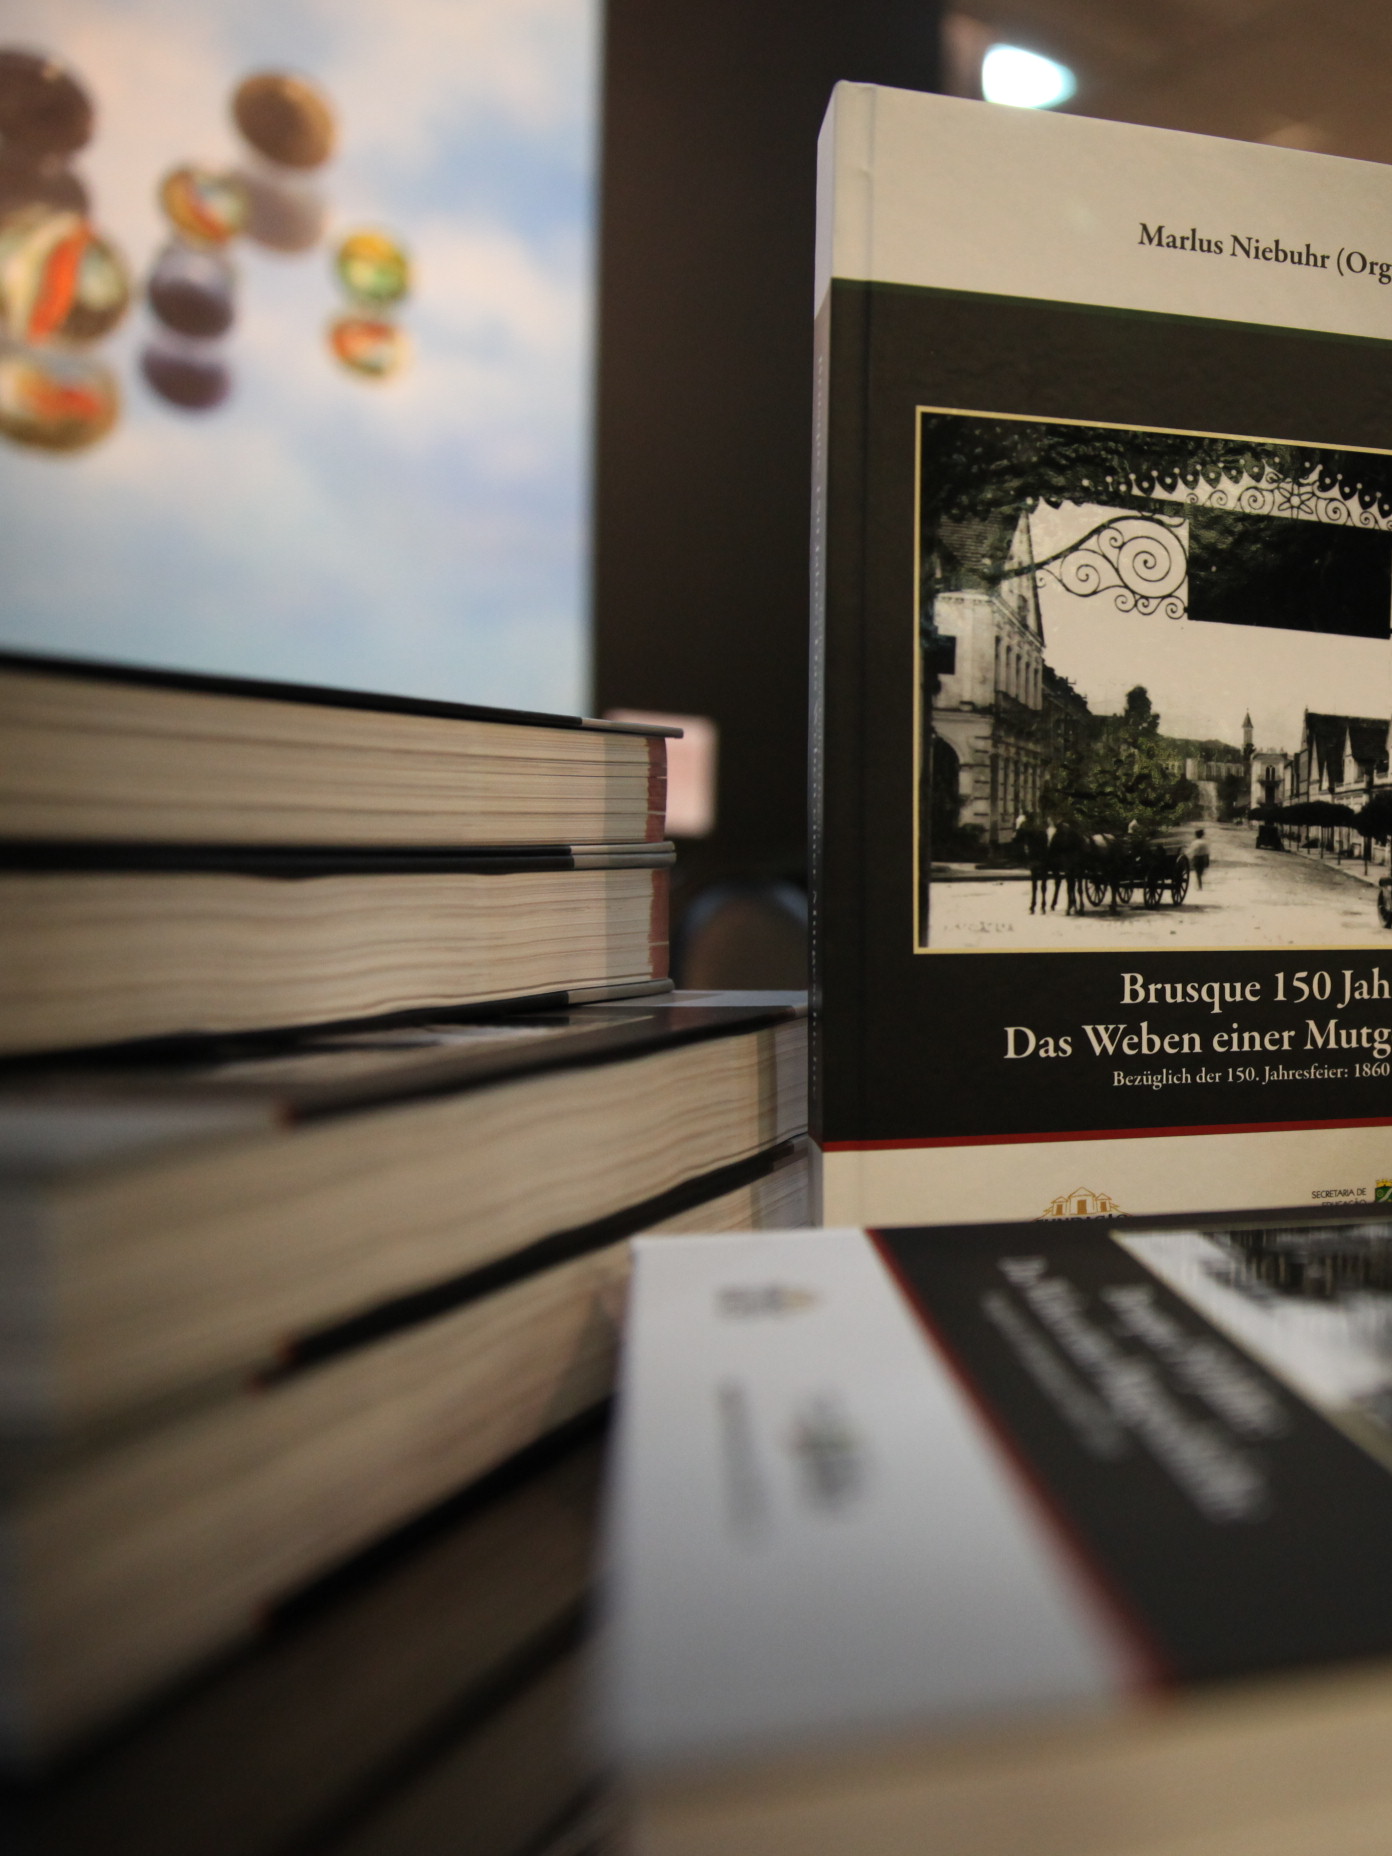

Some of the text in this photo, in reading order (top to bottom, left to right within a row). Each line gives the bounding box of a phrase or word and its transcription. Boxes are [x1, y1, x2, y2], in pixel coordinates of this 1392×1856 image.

[1138, 223, 1223, 254] Marlus
[1230, 234, 1330, 268] Niebuhr
[1120, 972, 1261, 1013] Brusque
[1274, 970, 1331, 1003] 150
[1003, 1026, 1072, 1059] Das
[1081, 1021, 1202, 1056] Weben
[1212, 1022, 1295, 1052] einer
[1113, 1068, 1191, 1090] Bezüglich
[1196, 1067, 1221, 1083] der
[1227, 1067, 1259, 1082] 150.
[1261, 1063, 1348, 1085] Jahresfeier:
[1354, 1062, 1390, 1077] 1860
[1312, 1187, 1367, 1199] SECRETARIA DE
